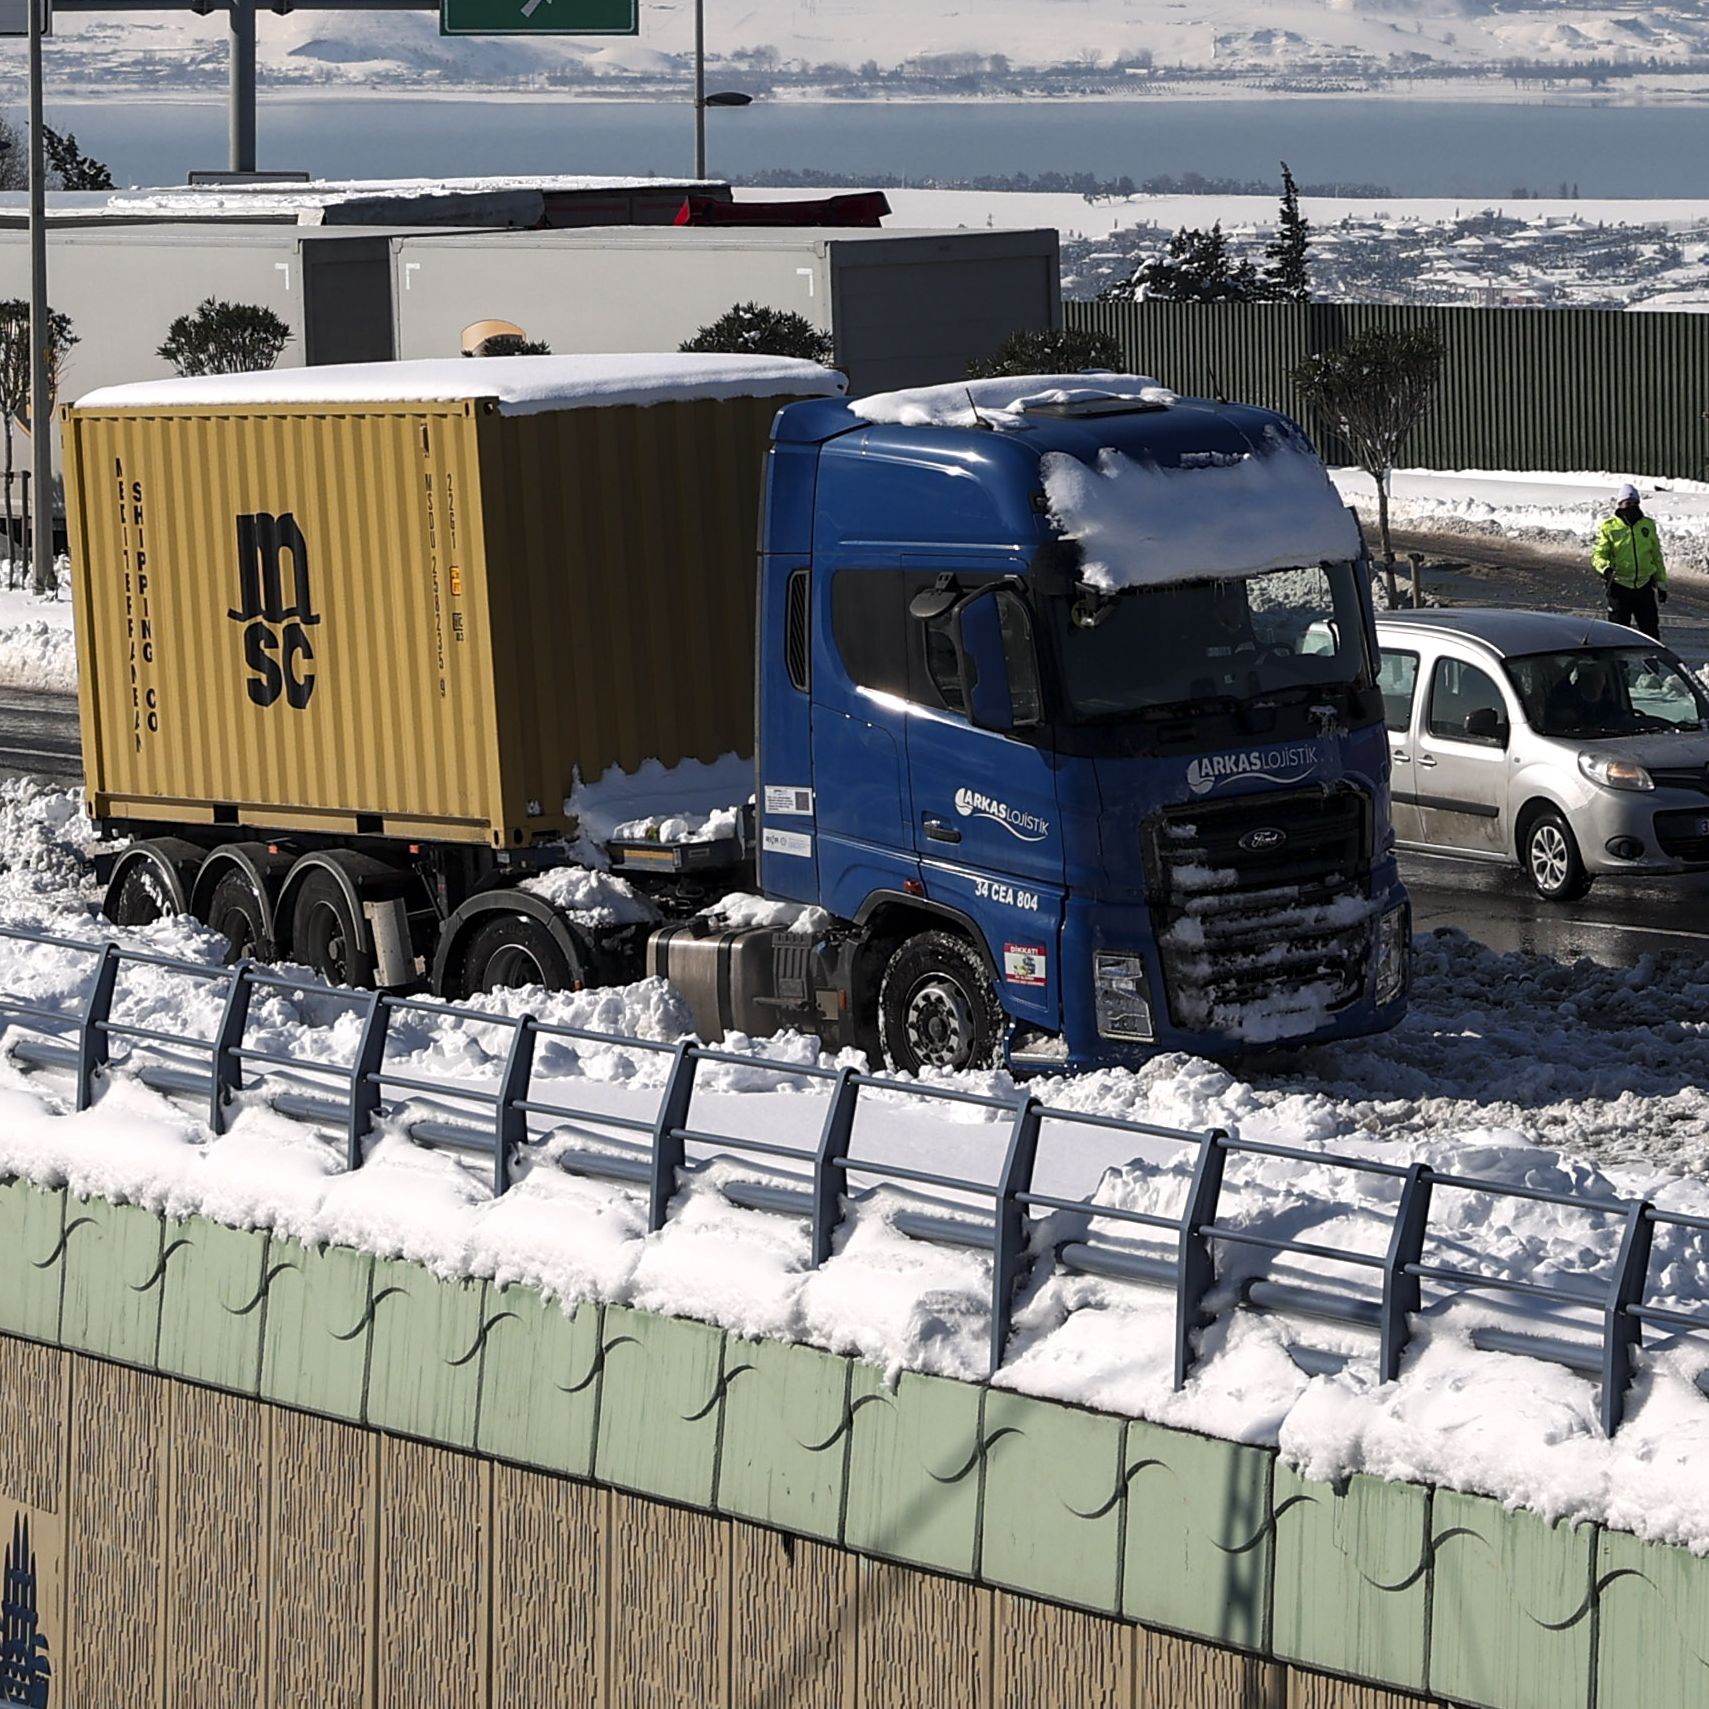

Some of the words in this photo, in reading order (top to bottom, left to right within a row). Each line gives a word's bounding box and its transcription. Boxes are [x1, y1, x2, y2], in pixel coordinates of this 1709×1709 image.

[132, 481, 154, 663] SHIPPING
[1201, 751, 1261, 777] ARKAS
[1251, 831, 1278, 848] Ford
[975, 880, 989, 898] 34
[991, 883, 1014, 906] CEA
[1016, 890, 1038, 911] 804
